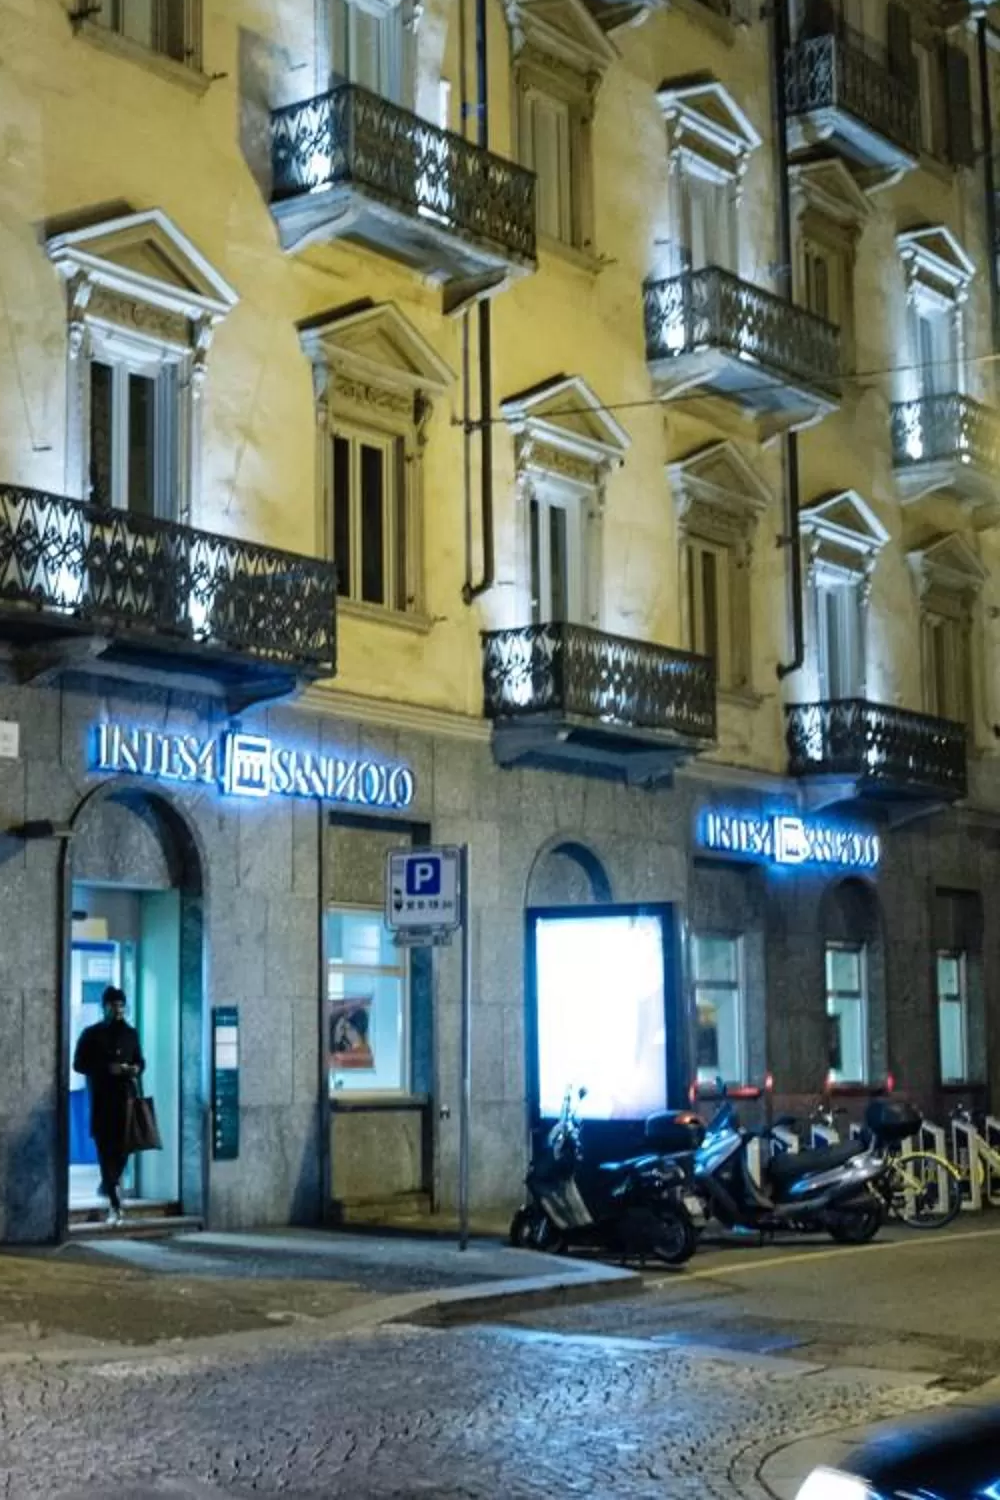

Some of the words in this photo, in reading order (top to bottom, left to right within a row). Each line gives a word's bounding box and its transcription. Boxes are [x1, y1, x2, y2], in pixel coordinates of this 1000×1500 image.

[99, 723, 217, 785] INTESA
[269, 747, 414, 807] SANPAOLO
[706, 812, 771, 856] INTESA
[801, 826, 880, 868] ANPAOLO
[414, 862, 434, 892] P
